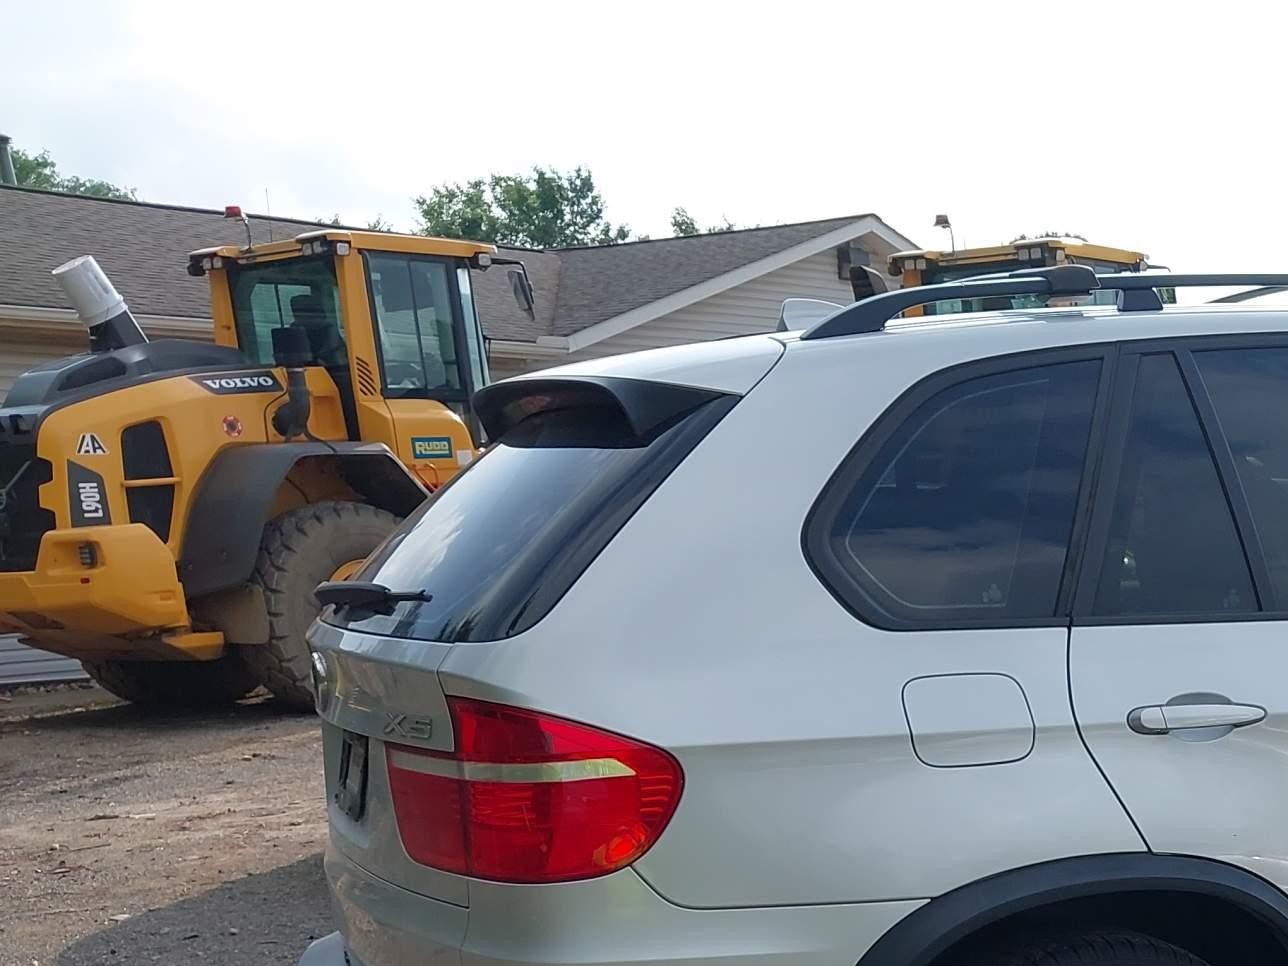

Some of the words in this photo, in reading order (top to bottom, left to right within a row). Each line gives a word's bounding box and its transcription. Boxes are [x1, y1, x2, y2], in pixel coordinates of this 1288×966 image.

[202, 376, 274, 389] VOLVO
[415, 441, 449, 455] RUDD
[77, 482, 104, 518] L90H
[384, 712, 433, 740] X5
